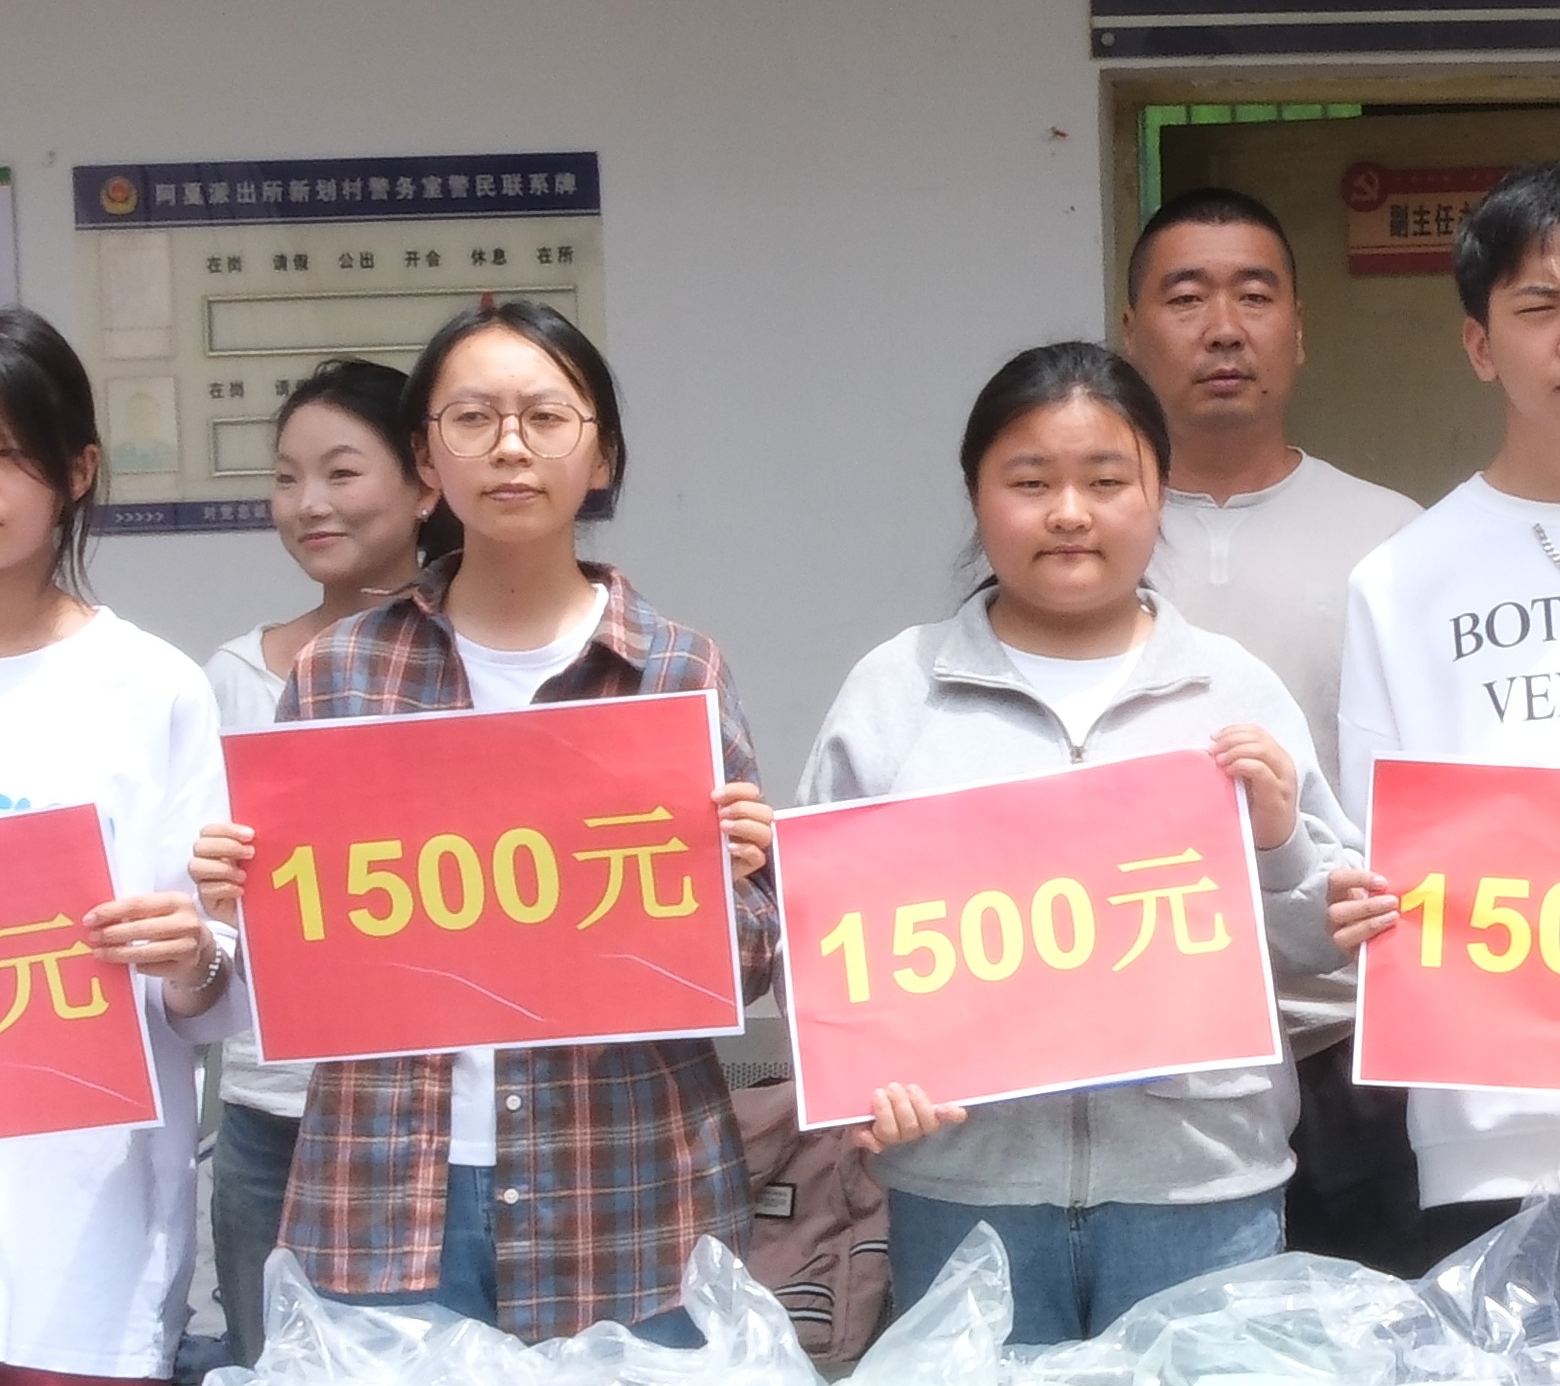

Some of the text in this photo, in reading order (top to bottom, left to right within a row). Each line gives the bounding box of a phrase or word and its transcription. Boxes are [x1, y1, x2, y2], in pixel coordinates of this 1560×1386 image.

[206, 244, 575, 275] 在岗 请假 公出 开会 休息 在所
[208, 379, 245, 400] 在岗
[272, 805, 699, 941] 1500元
[819, 846, 1232, 1003] 1500元
